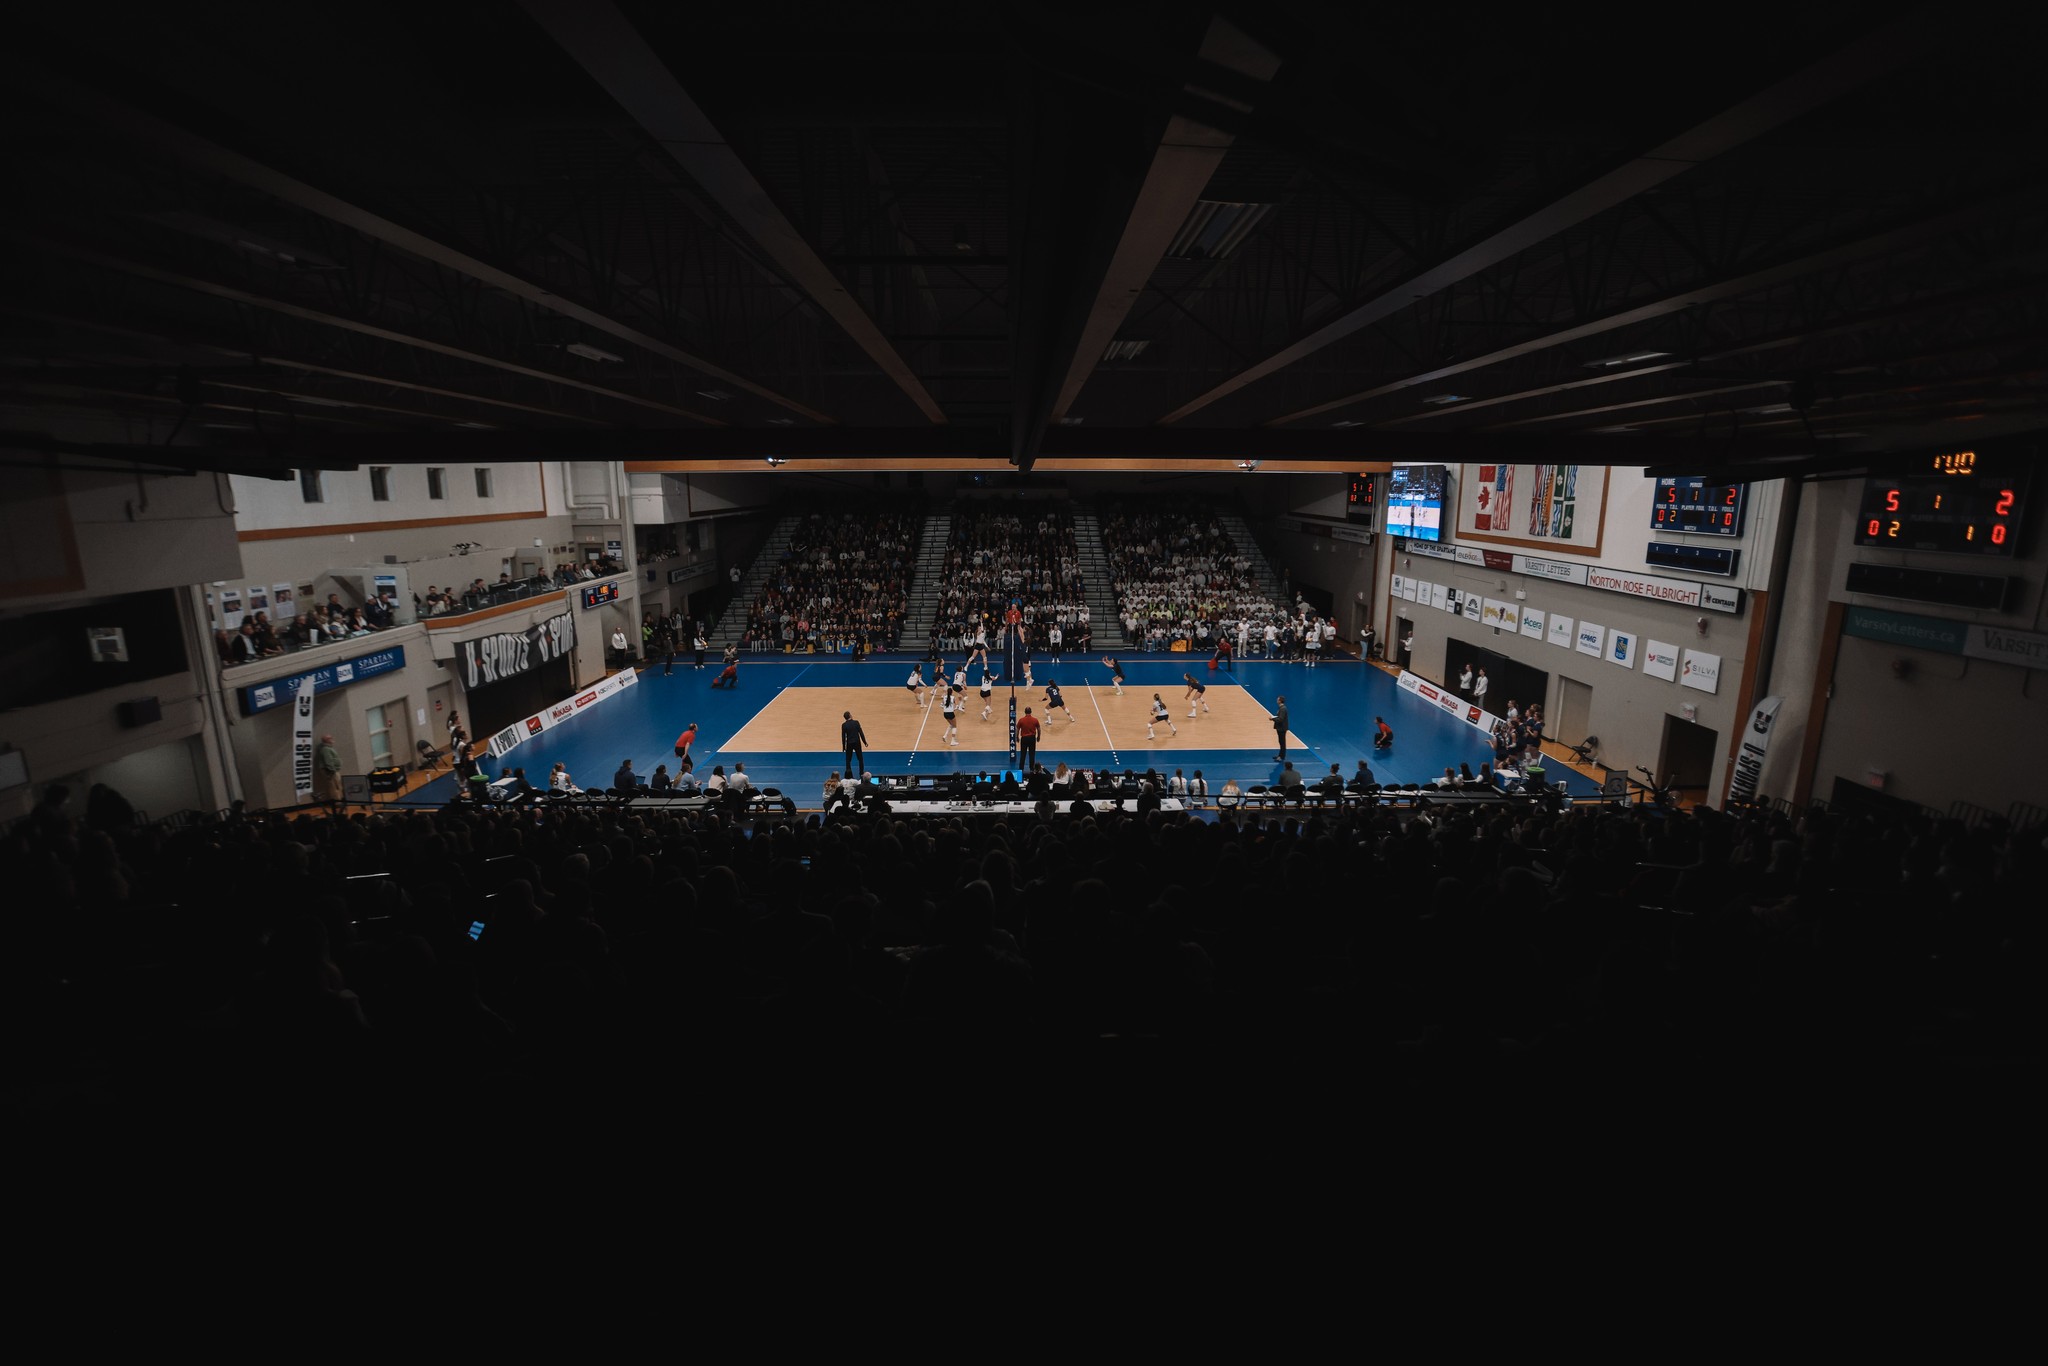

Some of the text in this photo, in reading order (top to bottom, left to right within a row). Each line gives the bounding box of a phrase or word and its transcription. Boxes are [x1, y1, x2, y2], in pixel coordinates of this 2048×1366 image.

[1668, 488, 1736, 505] 5 1 2
[1886, 489, 2015, 516] 5 1 2
[1658, 510, 1677, 522] 0 2
[1712, 513, 1732, 525] 1 0
[1867, 519, 1901, 538] 0 2
[1966, 523, 2007, 545] 1 0
[1525, 558, 1546, 572] VARSITY
[1547, 565, 1571, 576] LETTERS
[1590, 575, 1698, 604] NORTON ROSE FULBRIGHT
[1712, 598, 1735, 607] CENTAUR
[1524, 616, 1542, 630] Acera
[1854, 616, 1955, 643] VarsityLetters.ca
[1580, 634, 1597, 643] KPMG
[1984, 629, 2048, 658] VARSIT
[358, 652, 394, 668] SPARTAN
[465, 632, 531, 688] U SPORTS
[337, 668, 352, 678] BOX
[1692, 664, 1716, 676] SILVA
[288, 670, 330, 689] SPTAN
[256, 690, 274, 702] BOX
[1440, 695, 1458, 710] MIKASA
[552, 704, 573, 719] MIKASA
[494, 728, 517, 754] U SPORTS
[296, 744, 311, 790] SPORTS
